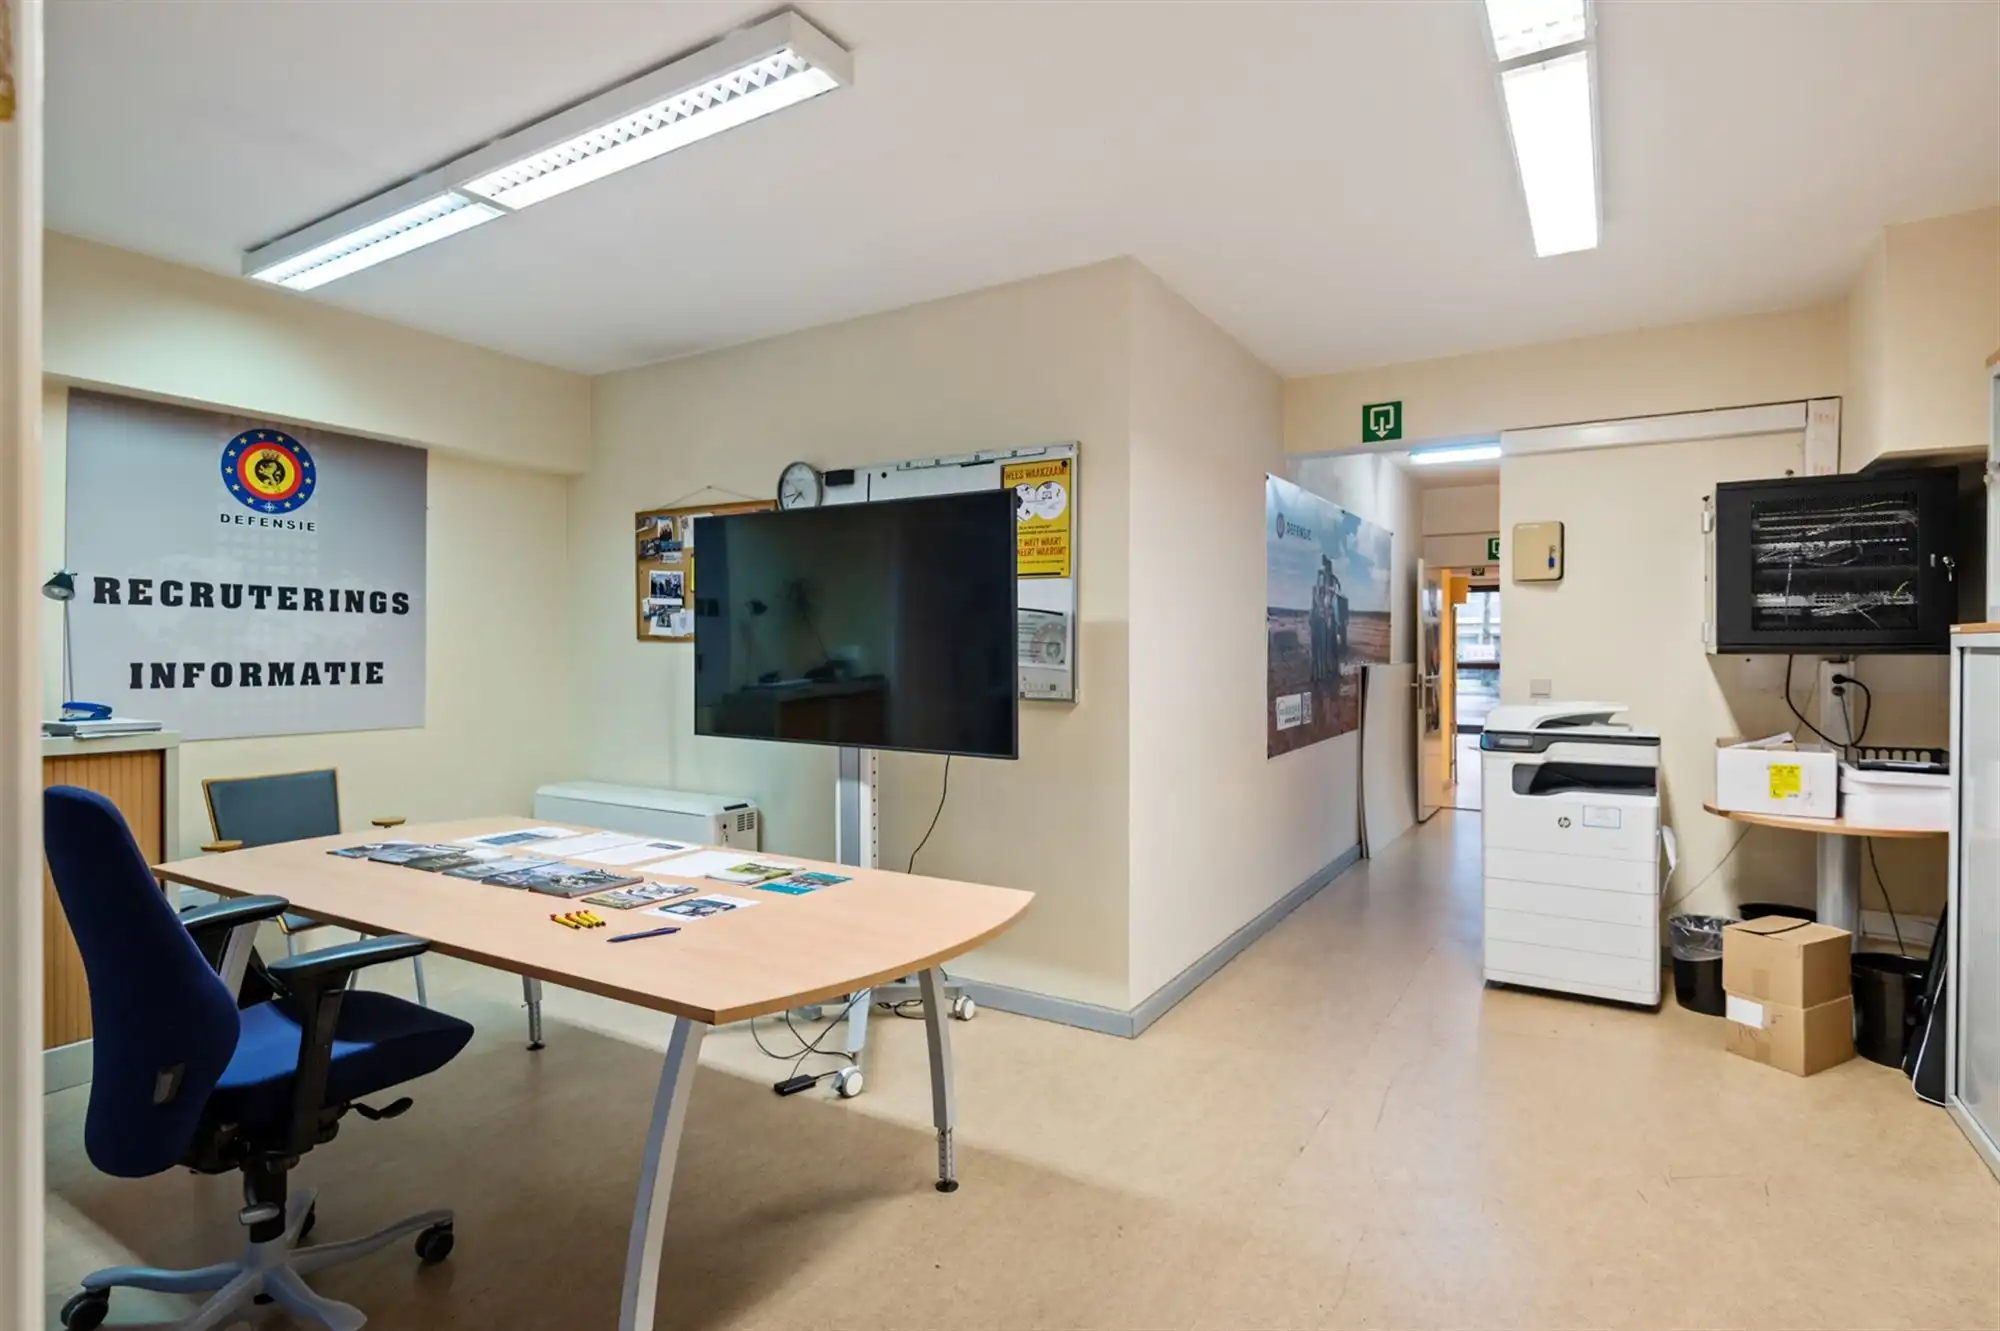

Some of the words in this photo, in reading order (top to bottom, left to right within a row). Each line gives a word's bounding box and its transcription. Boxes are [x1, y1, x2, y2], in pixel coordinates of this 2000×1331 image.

[1006, 469, 1023, 480] WEES
[220, 514, 315, 531] DEFENSIE
[93, 576, 410, 616] RECRUTERINGS
[129, 661, 384, 690] INFORMATIE
